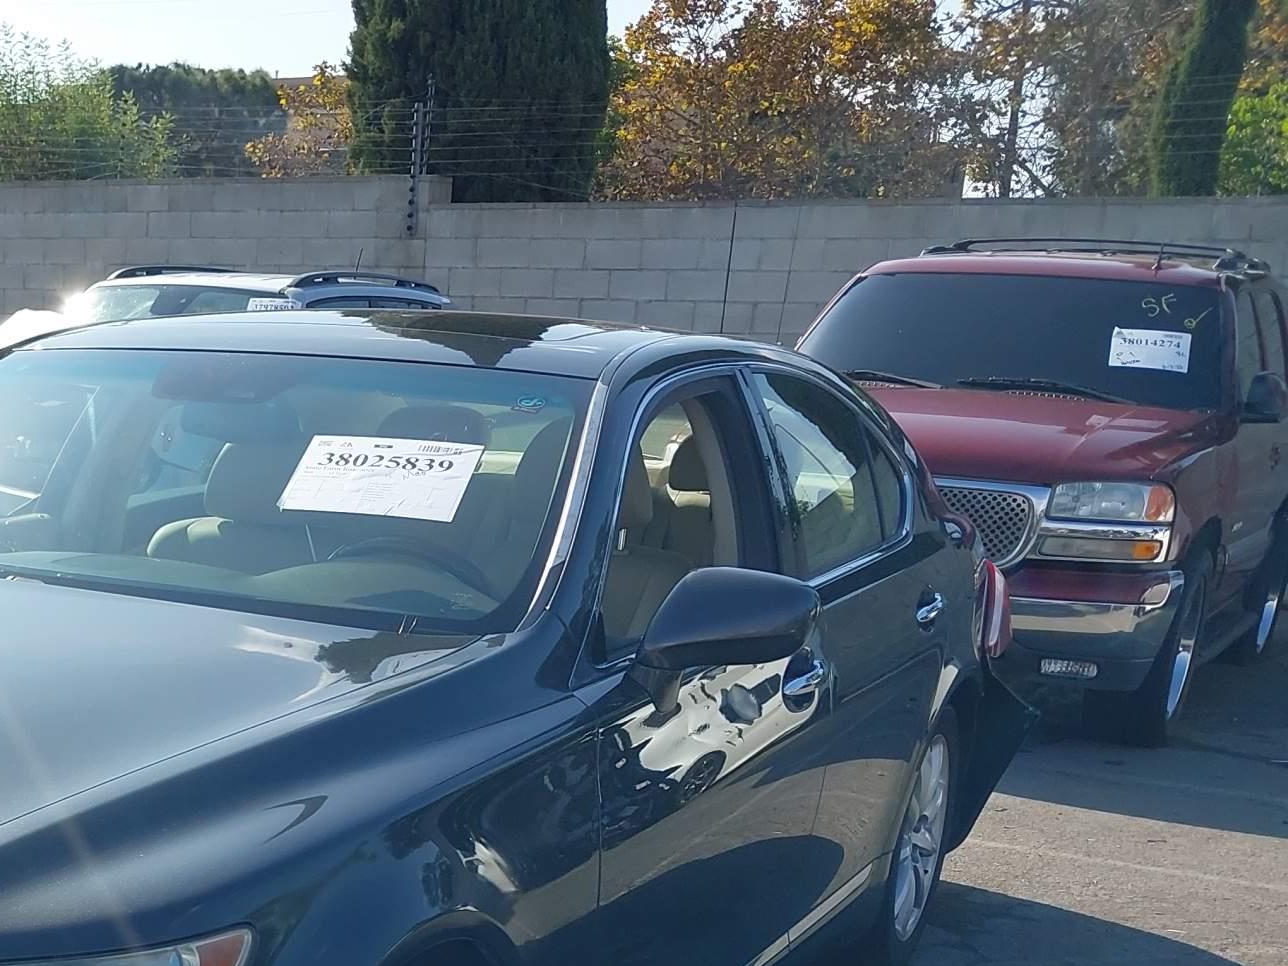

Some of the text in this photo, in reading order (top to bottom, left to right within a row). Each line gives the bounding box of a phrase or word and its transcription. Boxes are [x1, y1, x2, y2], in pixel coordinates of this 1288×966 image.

[1141, 293, 1177, 317] SF
[1119, 337, 1181, 349] 38014274
[317, 452, 454, 472] 38025839
